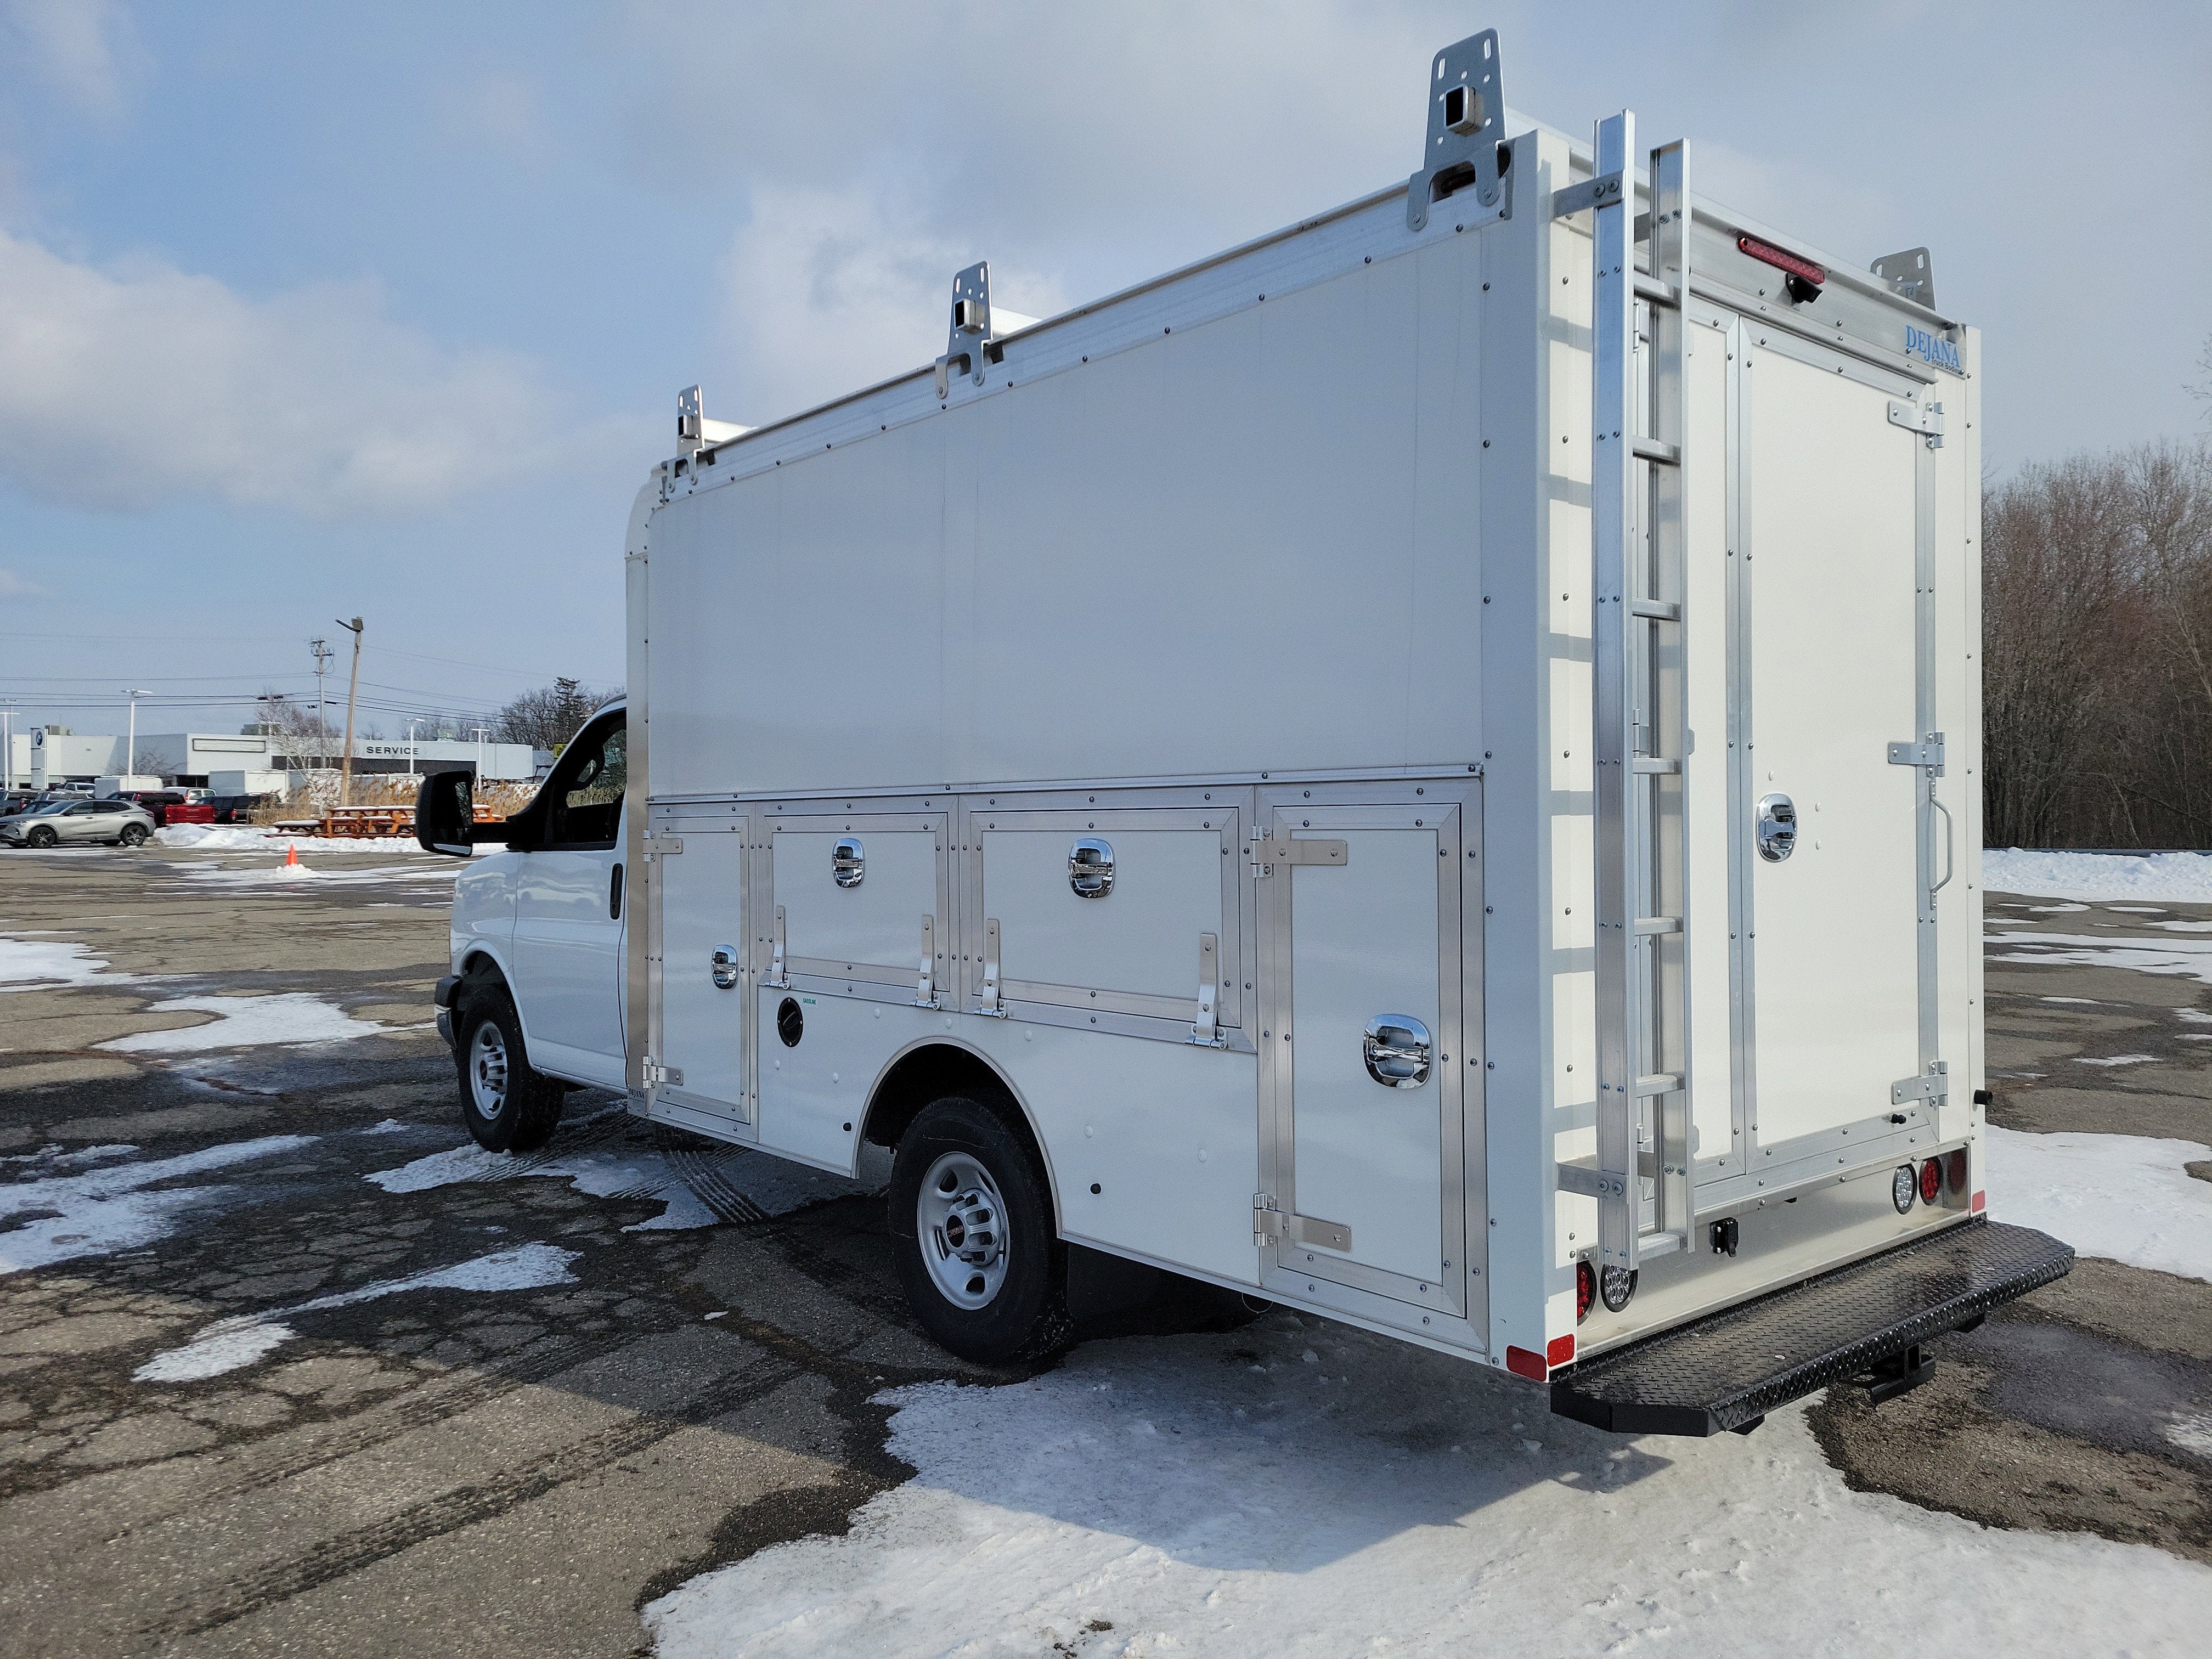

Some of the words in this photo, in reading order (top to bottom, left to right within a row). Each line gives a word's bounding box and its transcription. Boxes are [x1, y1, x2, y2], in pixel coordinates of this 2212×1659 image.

[1906, 325, 1960, 368] DEJANA
[1931, 357, 1944, 367] Truck
[366, 746, 419, 755] SERVICE
[628, 1088, 645, 1098] DEJANA
